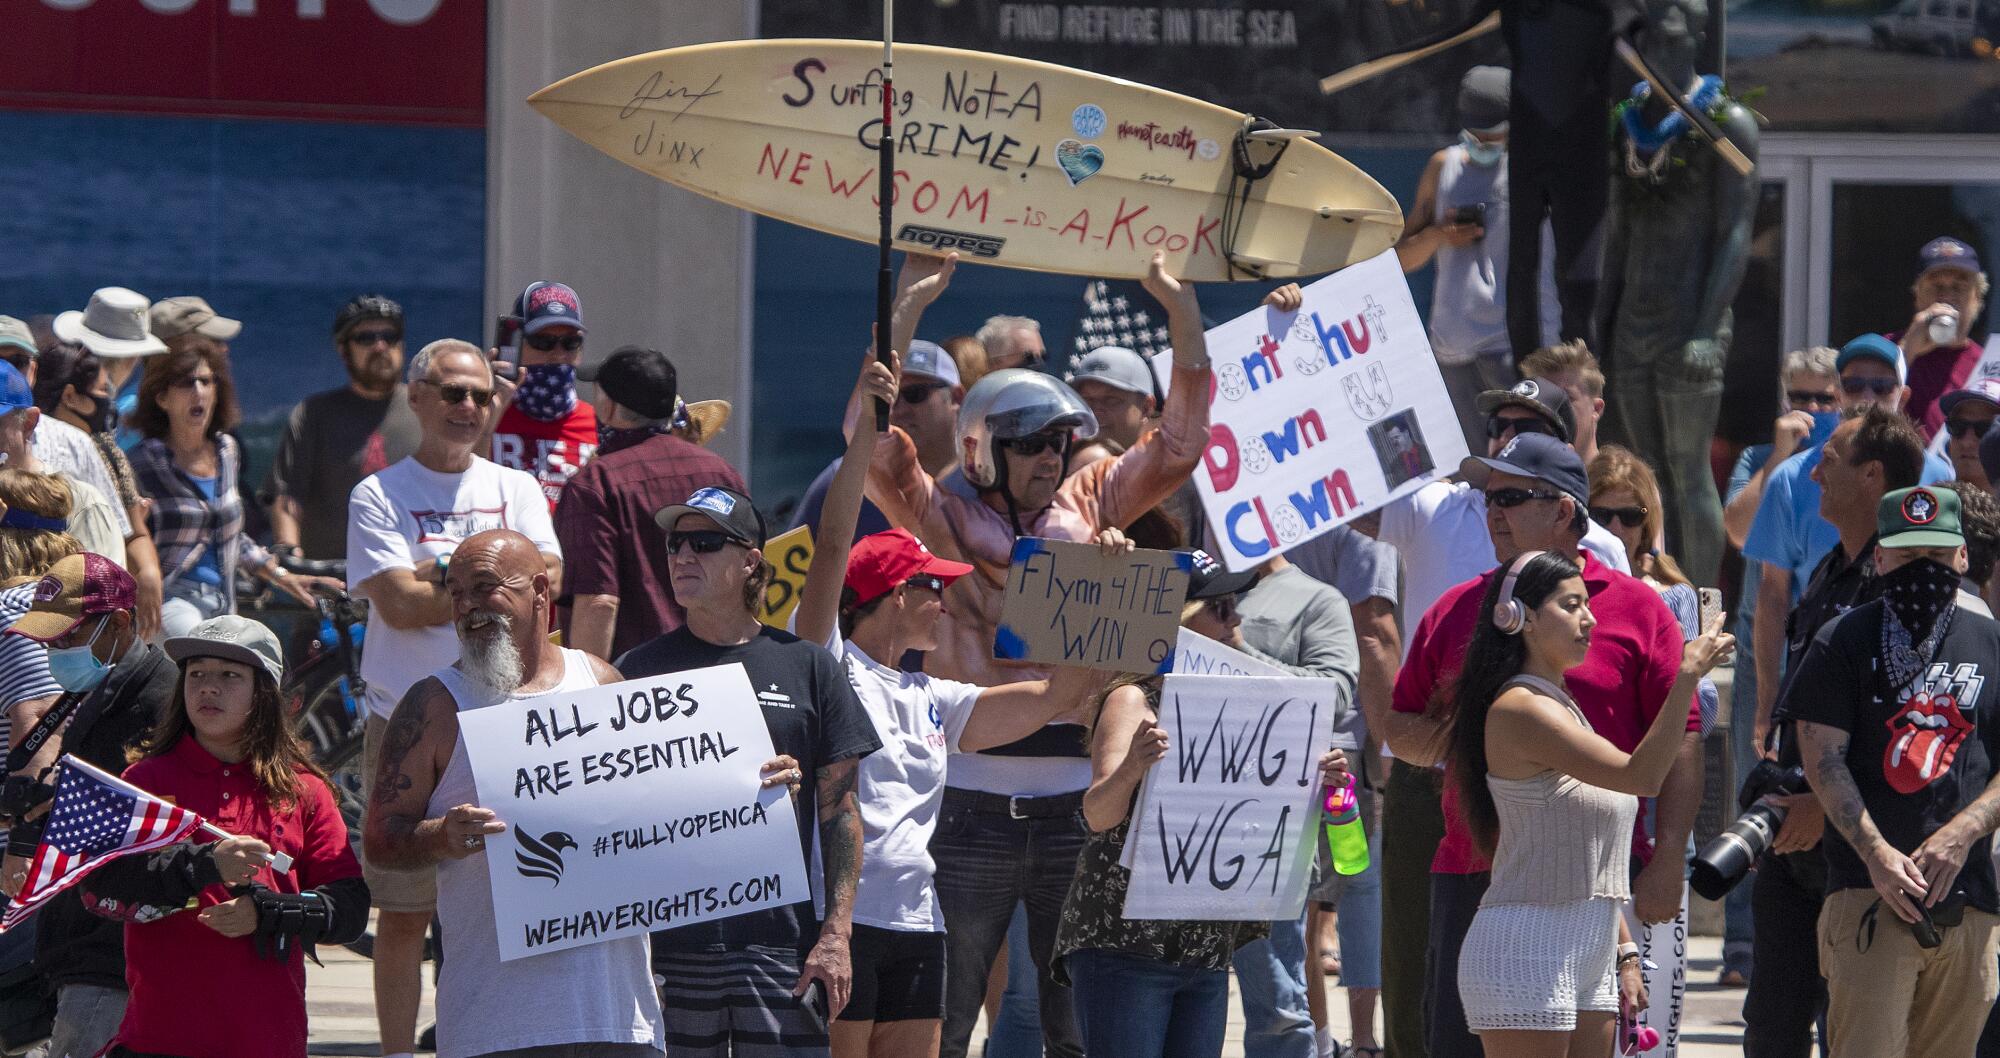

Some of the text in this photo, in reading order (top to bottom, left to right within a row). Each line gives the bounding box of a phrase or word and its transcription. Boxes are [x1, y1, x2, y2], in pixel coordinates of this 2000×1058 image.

[1000, 4, 1298, 45] FIND REFUGE IN THE SEA
[857, 118, 1040, 180] CRIME!
[1209, 294, 1388, 408] on't Shut
[1203, 360, 1394, 493] Down U
[1018, 551, 1101, 630] Flynn
[1061, 614, 1169, 664] WIN Q
[25, 724, 48, 751] EOS
[45, 711, 60, 727] 5D
[525, 683, 699, 748] ALL JOBS
[514, 731, 739, 800] ARE ESSENTIAL
[592, 801, 768, 858] #FULLYOPENCA
[1158, 798, 1291, 896] WGA
[525, 873, 781, 948] WEHAVERIGHTS.COM
